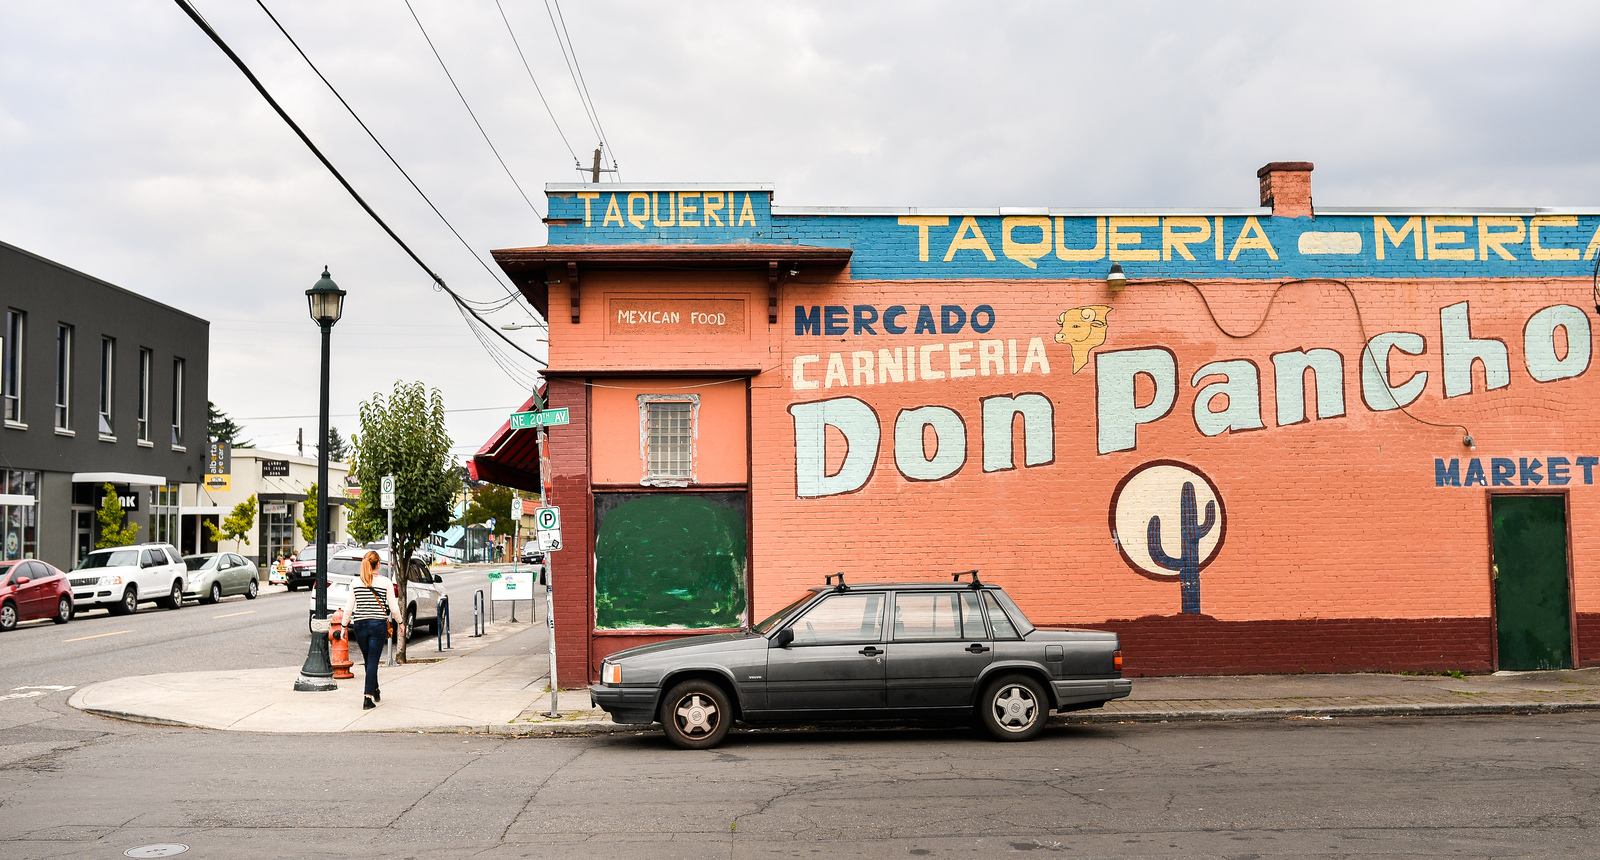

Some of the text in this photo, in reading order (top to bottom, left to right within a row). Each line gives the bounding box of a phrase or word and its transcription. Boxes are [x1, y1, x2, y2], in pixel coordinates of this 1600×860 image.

[577, 191, 757, 229] TAQUERIA
[898, 215, 1600, 269] TAQUERIA MERC
[617, 309, 726, 327] MEXICAN FOOD
[794, 304, 996, 336] MERCADO
[792, 336, 1051, 390] CARNICERIA
[787, 300, 1592, 499] Don Pancho
[512, 411, 566, 426] NE 20TH AV
[1434, 455, 1600, 487] MARKET
[544, 513, 553, 525] P
